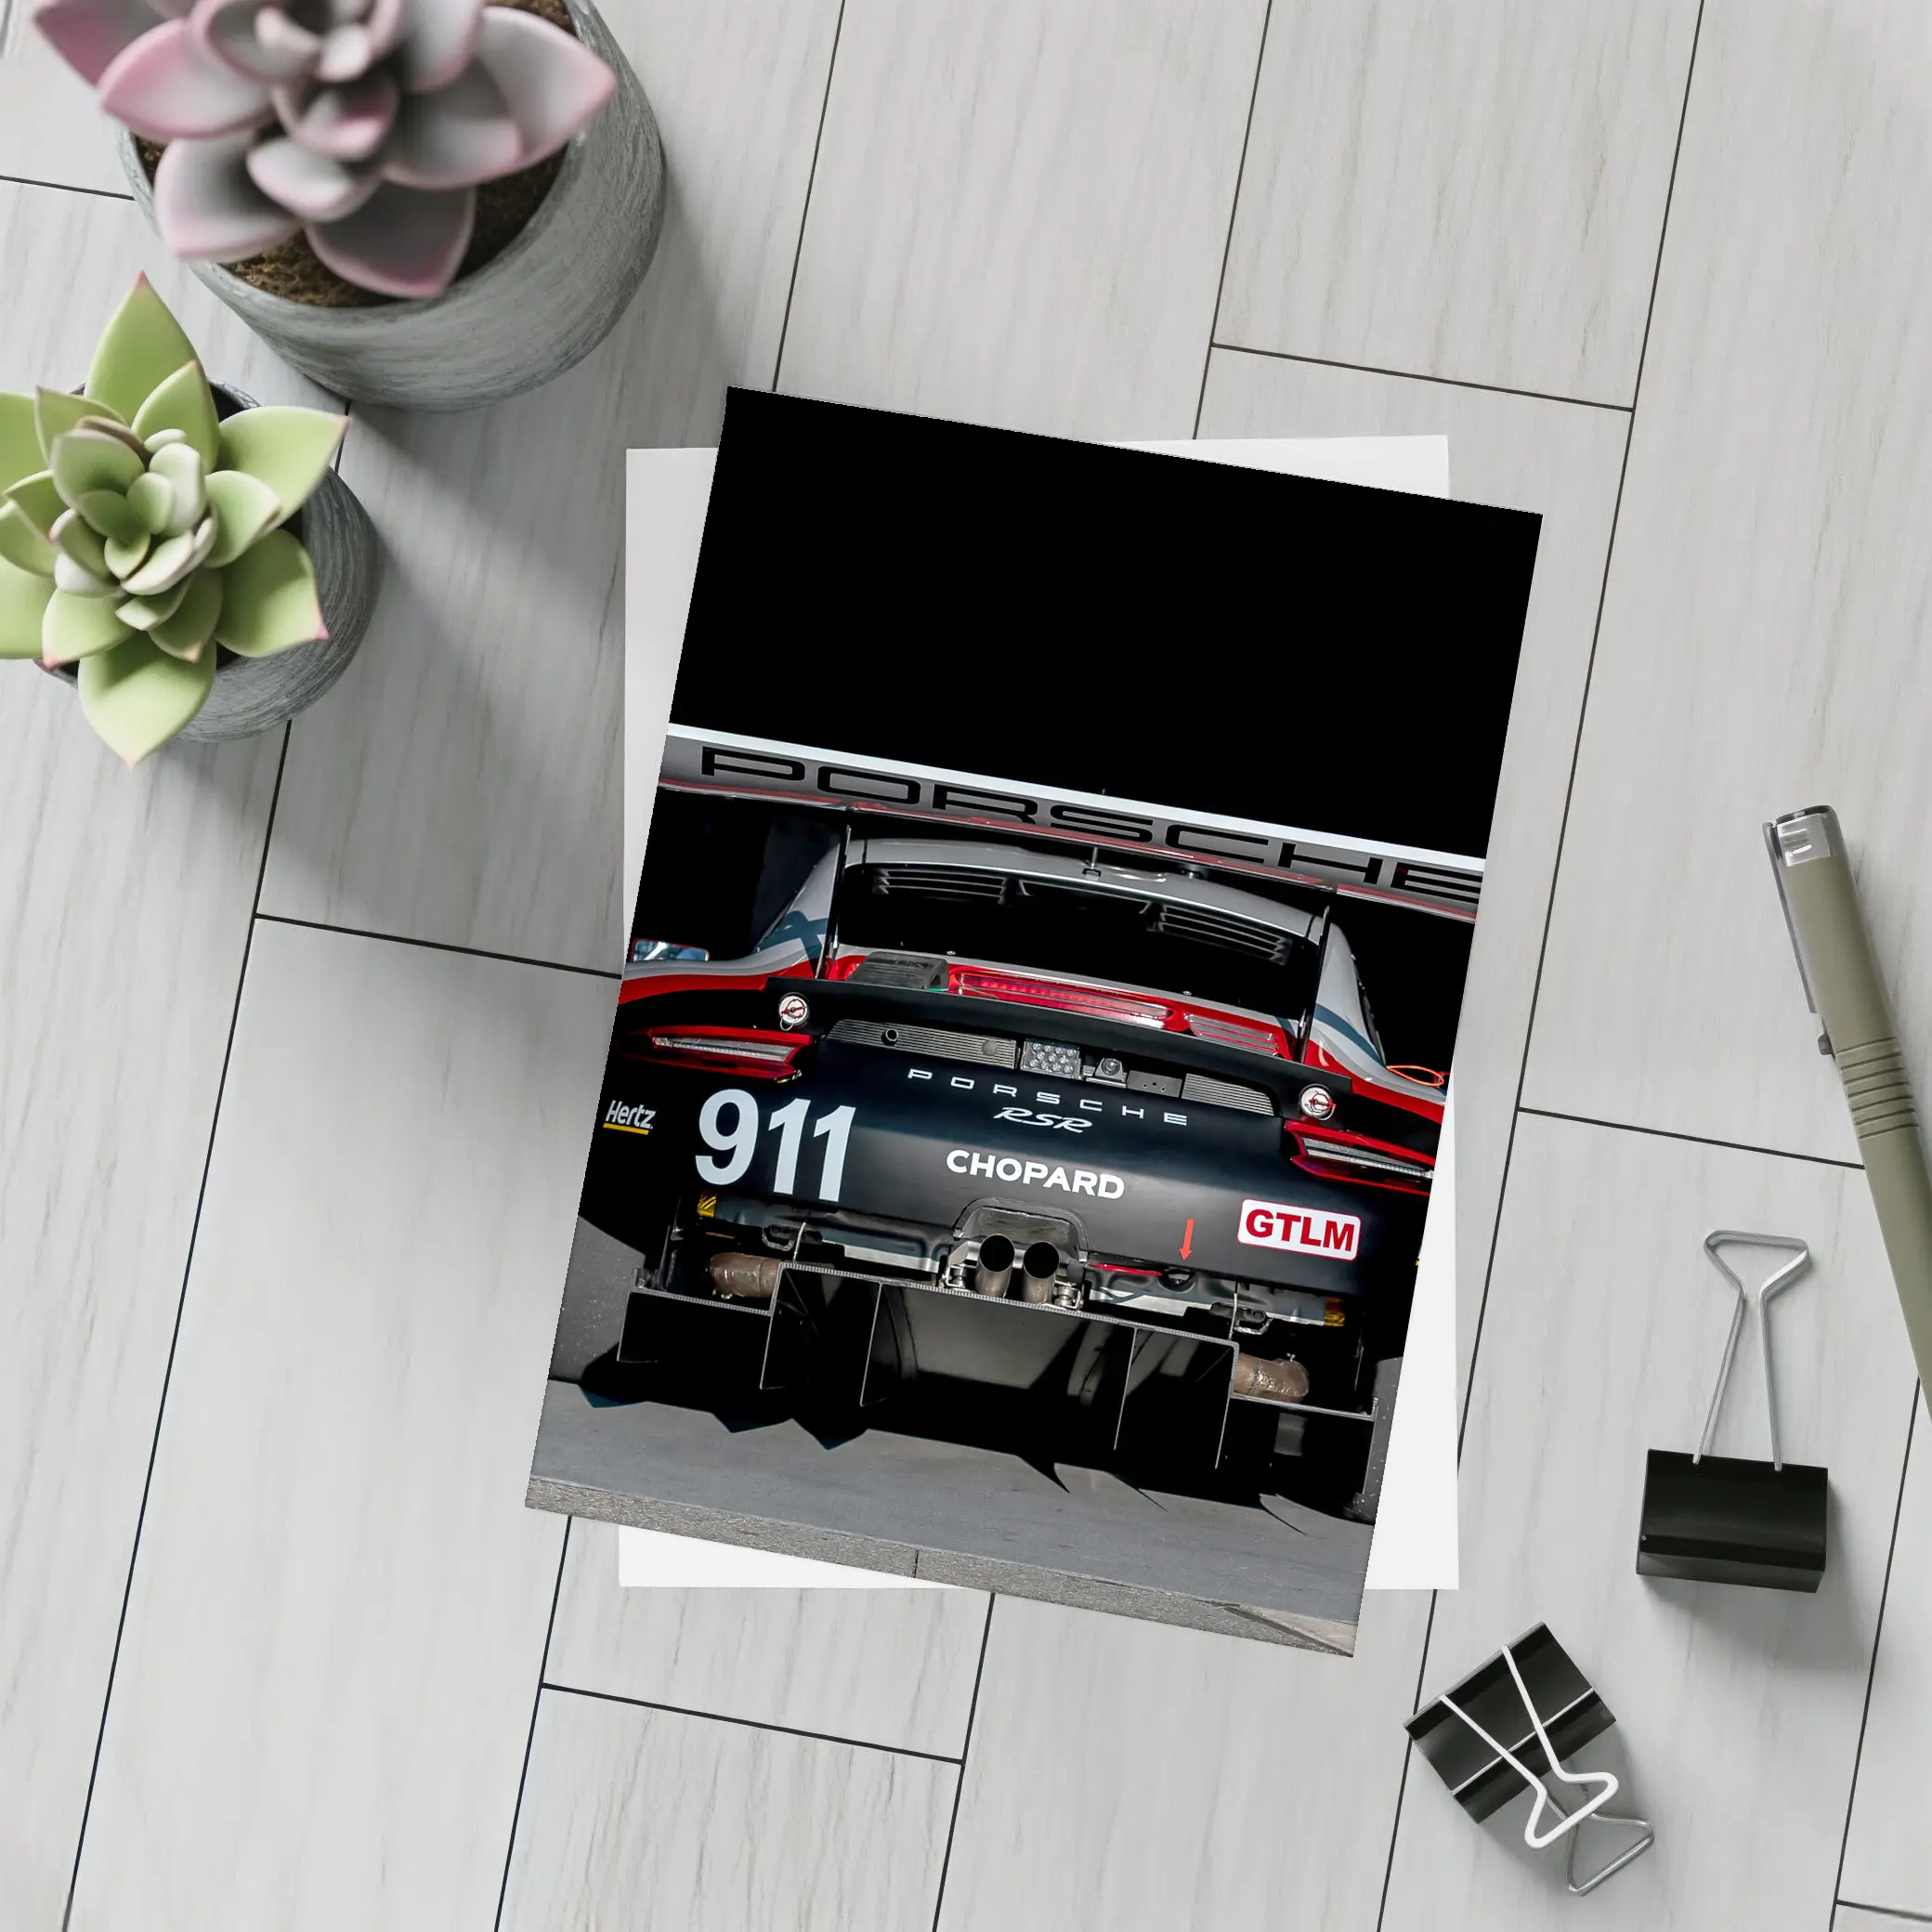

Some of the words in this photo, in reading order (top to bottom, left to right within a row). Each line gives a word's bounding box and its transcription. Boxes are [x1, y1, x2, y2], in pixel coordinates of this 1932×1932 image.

[701, 745, 1482, 904] PORSCHE
[907, 1068, 1187, 1126] PORSCHE
[993, 1107, 1092, 1133] RSR
[695, 1089, 856, 1202] 911
[946, 1149, 1125, 1200] CHOPARD
[1246, 1208, 1355, 1252] GTLM
